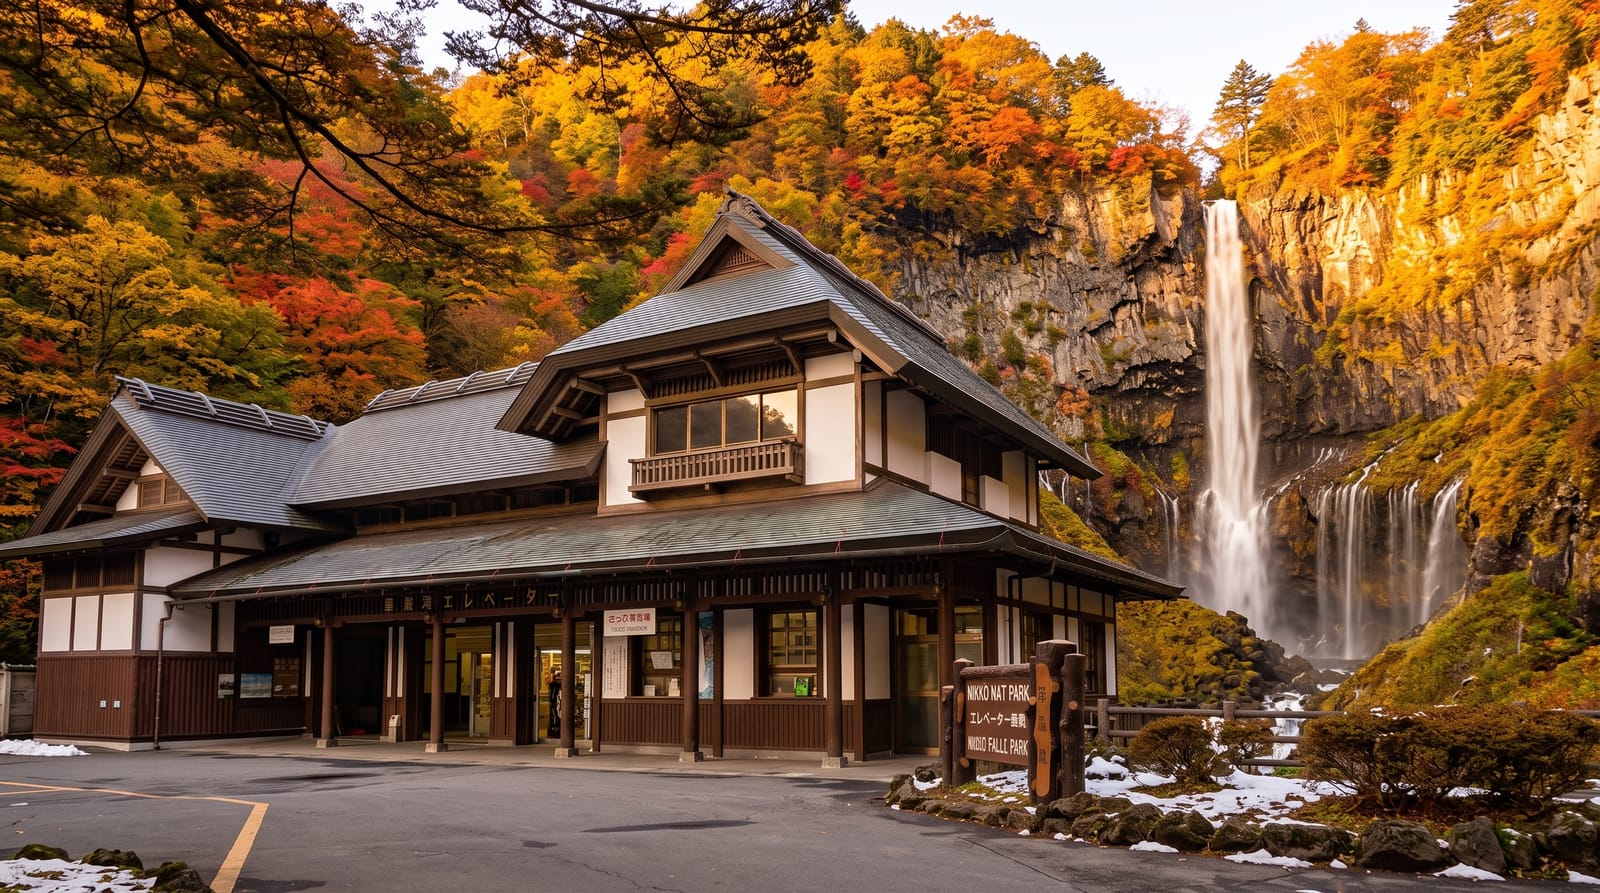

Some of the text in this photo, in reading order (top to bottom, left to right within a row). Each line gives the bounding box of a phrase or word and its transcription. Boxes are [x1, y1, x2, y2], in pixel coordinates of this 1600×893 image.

[967, 684, 1030, 702] NIKKO NAT PARK
[1009, 738, 1029, 757] PARK
